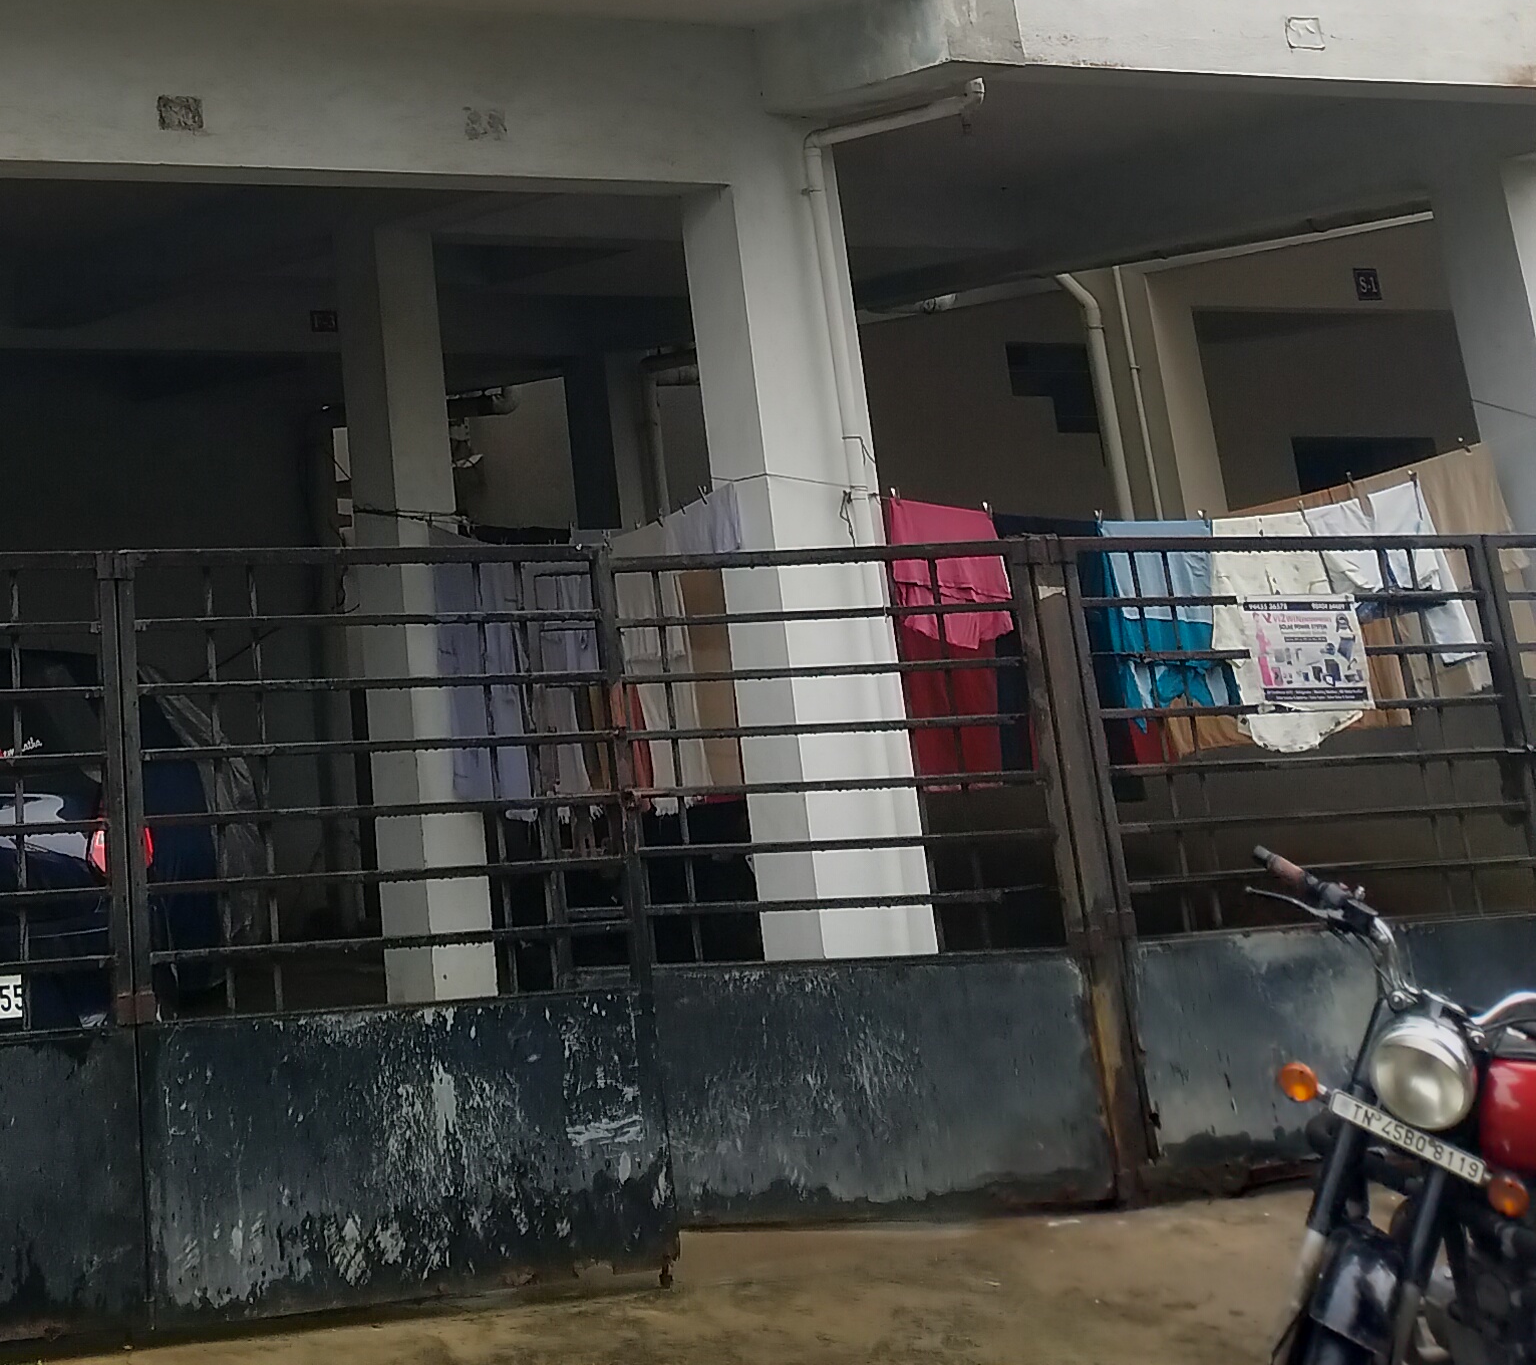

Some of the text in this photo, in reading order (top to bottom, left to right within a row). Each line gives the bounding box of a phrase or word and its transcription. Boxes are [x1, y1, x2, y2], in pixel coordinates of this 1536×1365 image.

[1359, 276, 1378, 293] S-1
[1354, 1103, 1375, 1127] TN
[1433, 1144, 1480, 1179] 8119
